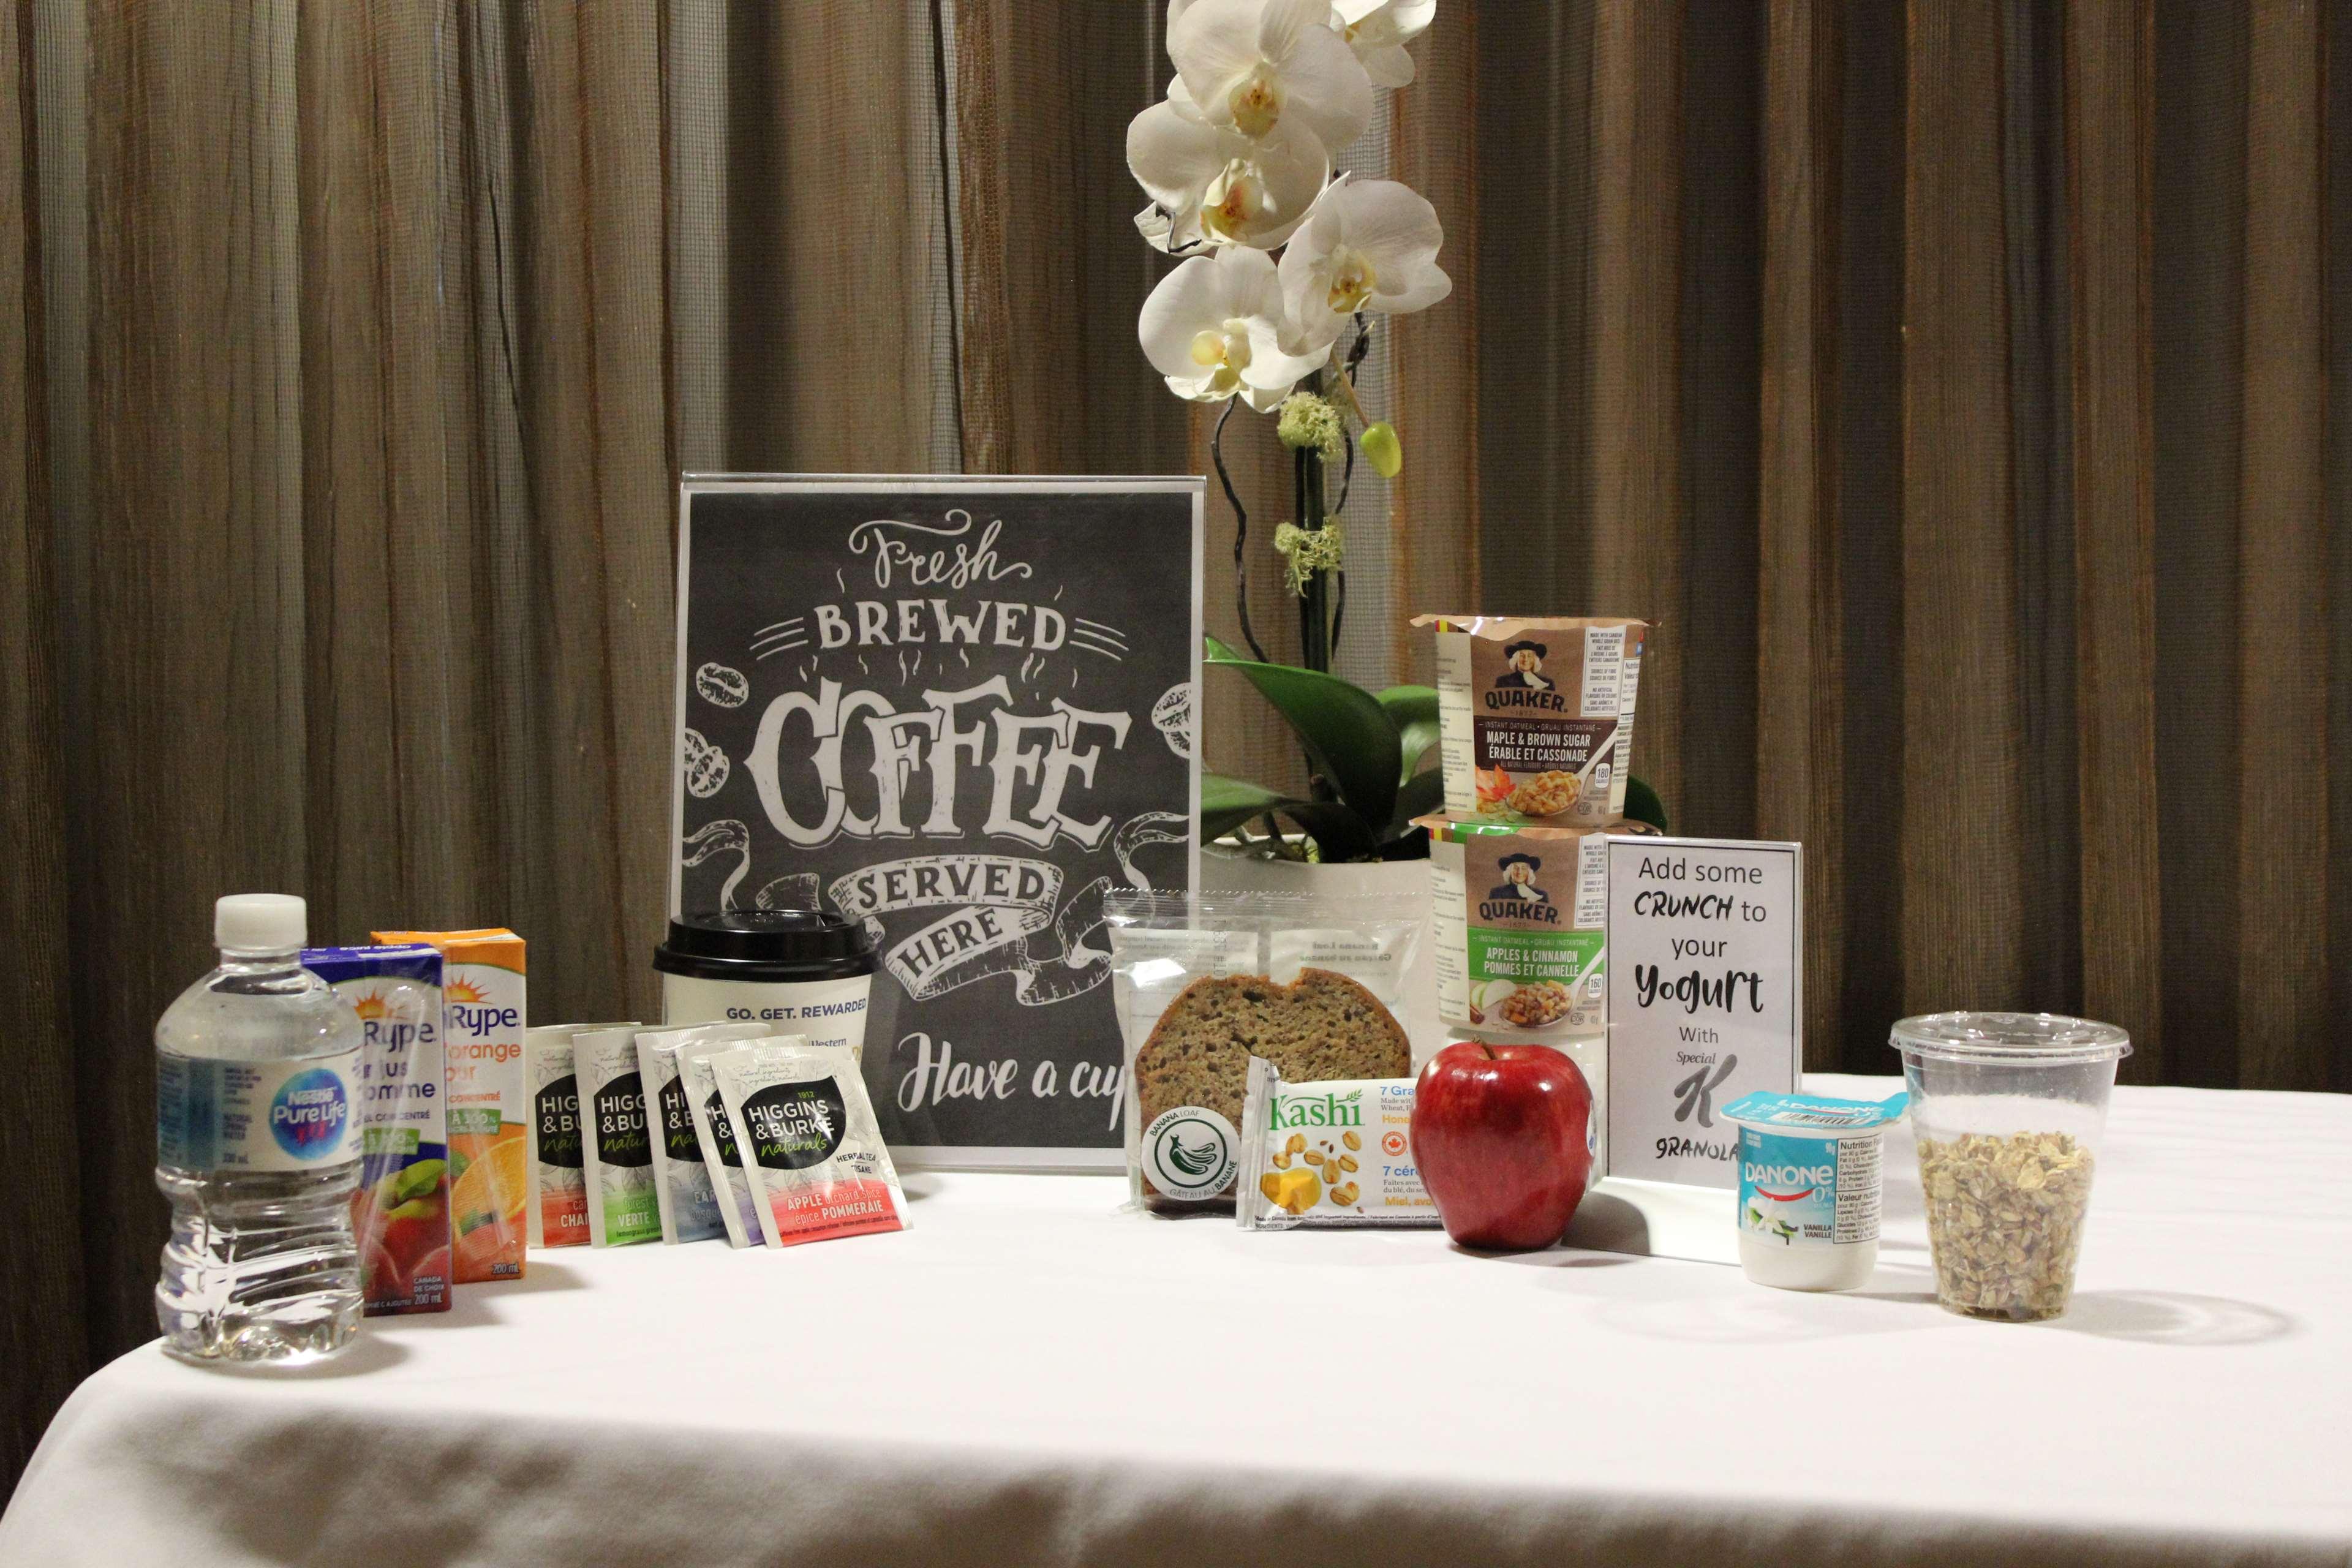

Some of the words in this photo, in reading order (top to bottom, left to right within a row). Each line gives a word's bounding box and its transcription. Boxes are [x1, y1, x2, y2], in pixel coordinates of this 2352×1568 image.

[850, 509, 1033, 589] Fresh
[814, 599, 1066, 650] BREWED
[1485, 690, 1564, 712] QUAKER
[1487, 731, 1516, 745] MAPLE
[1518, 733, 1525, 745] &
[1527, 733, 1561, 747] BROWN
[1562, 734, 1591, 747] SUGAR
[745, 675, 1133, 846] COFFEE
[1489, 743, 1522, 760] ÉRABLE
[1524, 748, 1534, 761] ET
[1537, 748, 1588, 762] CASSONADE
[1597, 768, 1609, 778] 180
[1638, 858, 1686, 880] Add
[1695, 865, 1763, 885] some
[857, 864, 1045, 909] SERVED
[1479, 902, 1558, 924] QUAKER
[1634, 891, 1733, 922] CRUNCH
[1741, 900, 1766, 922] to
[899, 907, 1003, 979] HERE
[1672, 938, 1727, 960] your
[1486, 947, 1520, 962] APPLES
[1523, 949, 1529, 962] &
[1532, 949, 1578, 963] CINNAMON
[1484, 961, 1521, 976] POMMES
[1523, 963, 1534, 976] ET
[1536, 964, 1580, 977] CANNELLE
[1591, 978, 1602, 988] 160
[1635, 963, 1763, 1014] Yogurt
[726, 1008, 755, 1020] GO.
[760, 1008, 796, 1020] GET.
[802, 998, 866, 1018] REWARDED
[444, 1005, 520, 1036] Rype
[1679, 1027, 1719, 1044] With
[1676, 1051, 1716, 1065] Special
[898, 1033, 1016, 1112] Have
[1031, 1060, 1059, 1097] a
[1380, 1087, 1387, 1095] 7
[1391, 1086, 1415, 1096] Gra
[1674, 1054, 1738, 1128] K
[274, 1105, 318, 1125] Pure
[322, 1101, 345, 1127] Life
[542, 1095, 579, 1113] HIG
[601, 1094, 646, 1113] HIGG
[748, 1099, 829, 1122] HIGGINS
[1268, 1093, 1365, 1130] Kashi
[1150, 1112, 1179, 1136] BANANA
[1382, 1114, 1411, 1124] Hone
[761, 1133, 827, 1157] naturals
[1841, 1140, 1872, 1150] Nutrition
[1204, 1188, 1216, 1197] AU
[1215, 1160, 1237, 1191] BANANE
[1383, 1166, 1391, 1176] 7
[788, 1194, 823, 1211] APPLE
[825, 1189, 859, 1205] orchard
[862, 1188, 881, 1204] spice
[821, 1200, 883, 1219] POMMERAIE
[617, 1212, 649, 1227] VERTE
[492, 1264, 507, 1274] 200
[415, 1294, 429, 1305] 200
